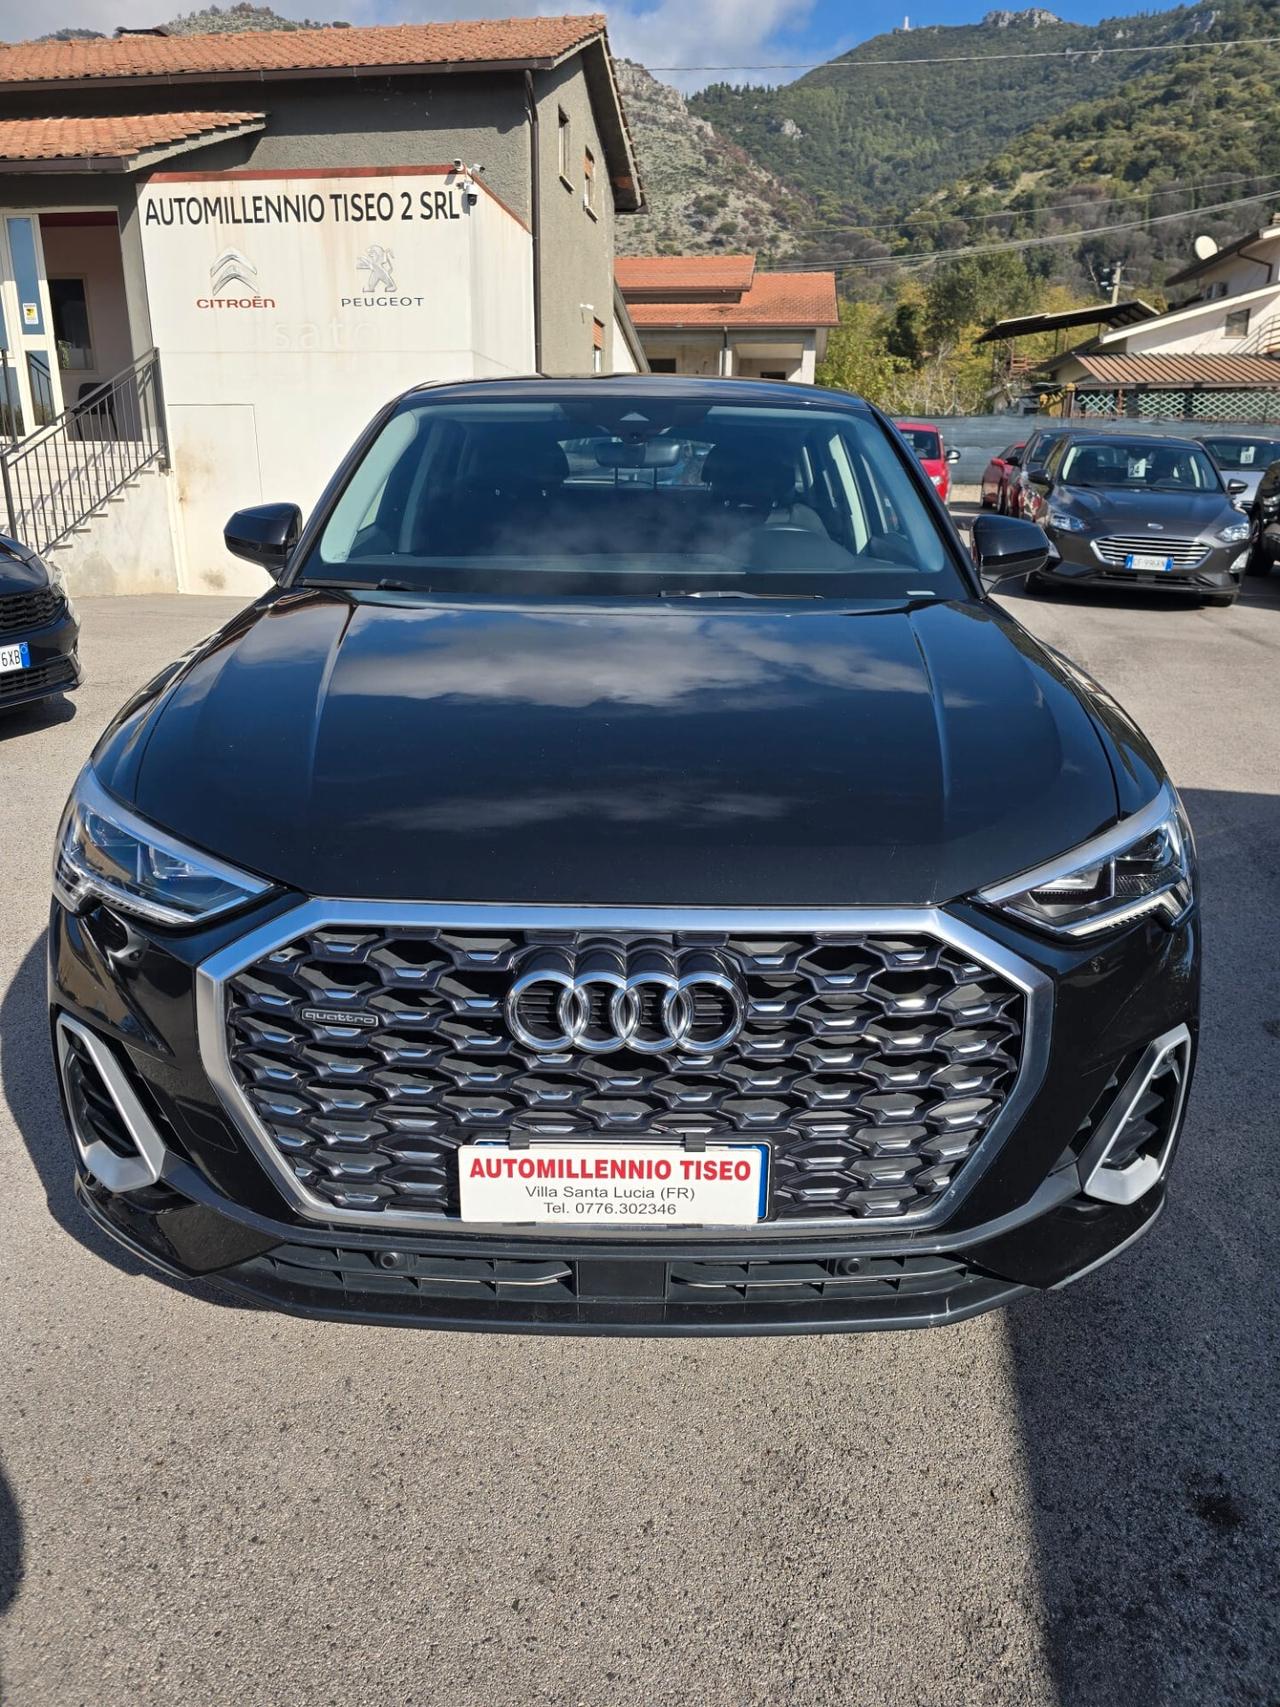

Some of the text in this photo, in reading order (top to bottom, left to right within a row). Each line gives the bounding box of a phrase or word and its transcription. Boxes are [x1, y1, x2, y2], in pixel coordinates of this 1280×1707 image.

[145, 190, 460, 226] AUTOMILLENNIO TISEO 2 SRL
[341, 297, 424, 308] PEUGEOT
[305, 1011, 375, 1024] quattro
[469, 1158, 751, 1182] AUTOMILLENNIO TISEO
[525, 1185, 696, 1202] Villa Santa Lucia (FR)
[544, 1202, 677, 1216] Tel. 0776.302346
